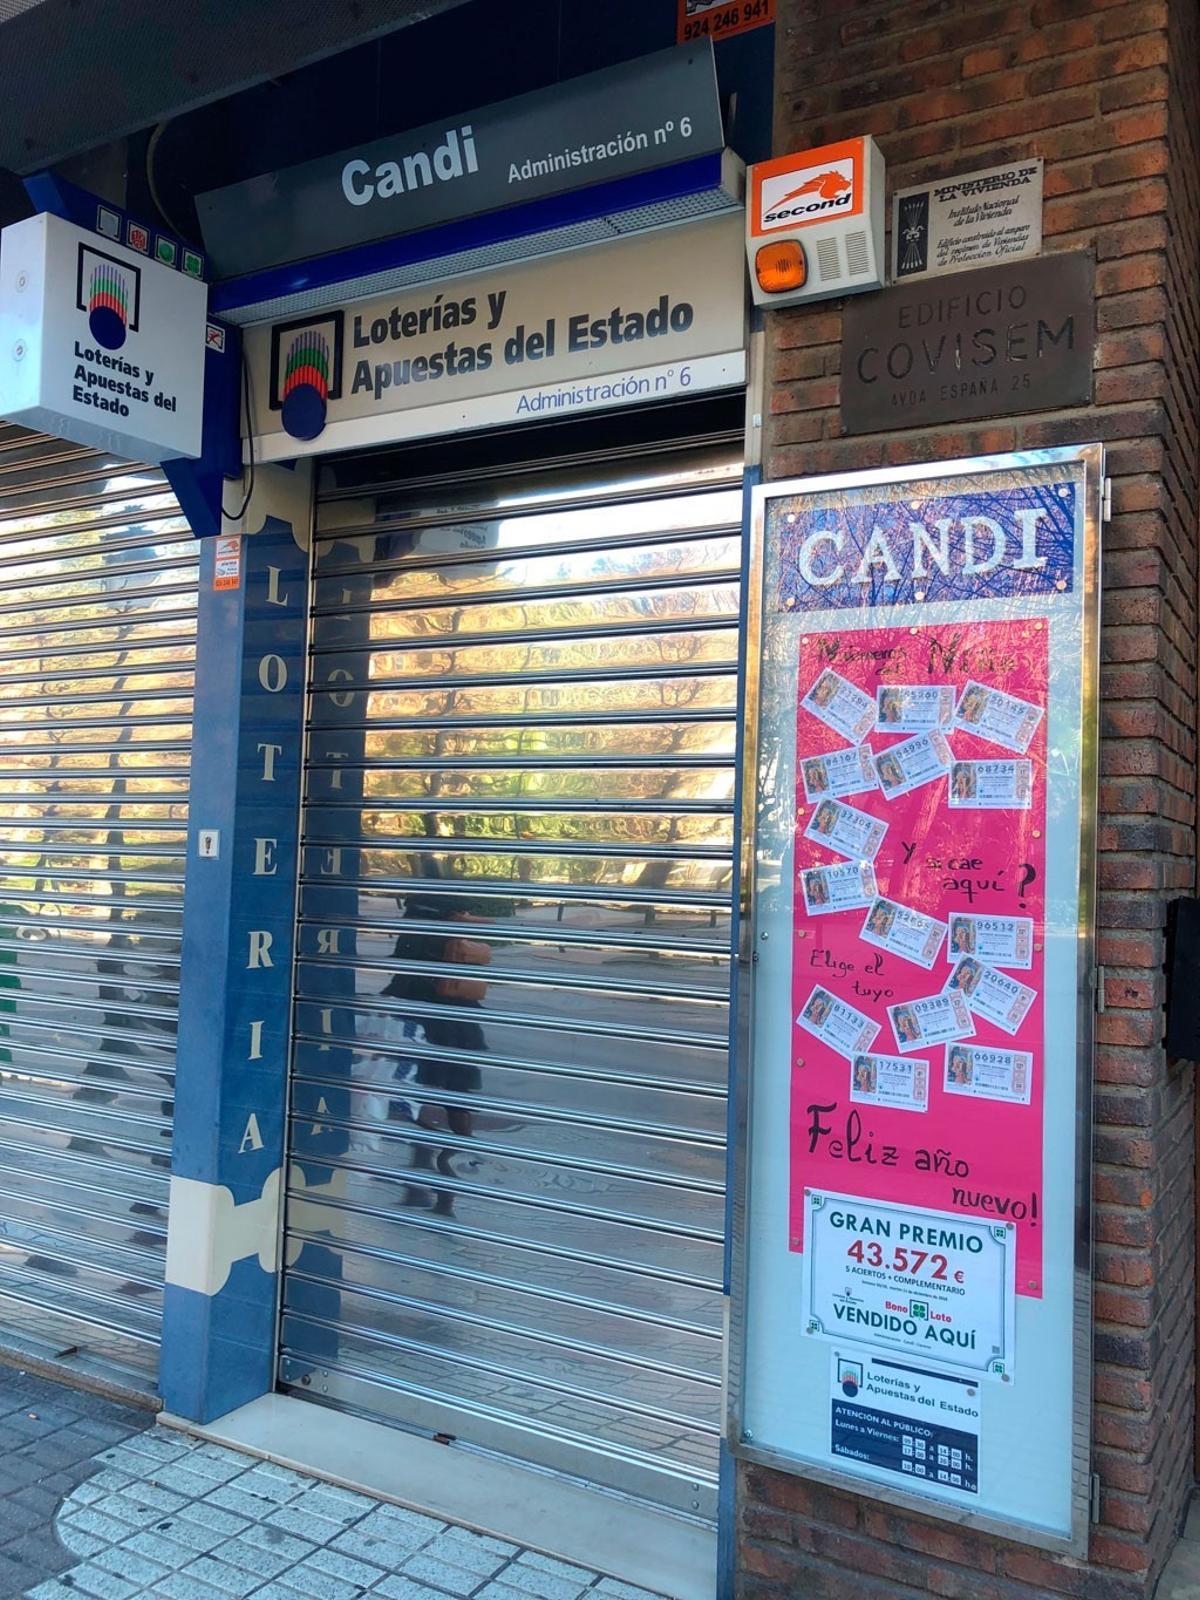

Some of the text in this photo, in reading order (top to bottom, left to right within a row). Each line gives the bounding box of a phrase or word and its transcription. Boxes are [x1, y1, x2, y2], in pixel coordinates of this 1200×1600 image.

[684, 0, 768, 40] 924 246 941
[342, 125, 480, 206] Candi
[508, 131, 648, 184] Administración
[680, 116, 692, 138] 6
[934, 166, 1037, 197] MINISTERIO DE
[939, 177, 1031, 202] LA VIVIENDA
[763, 193, 852, 223] second
[353, 291, 507, 349] Loterías y
[899, 285, 1027, 329] EDIFICIO
[74, 341, 154, 386] Loterías y
[351, 295, 694, 400] Apuestas del Estado
[857, 315, 1074, 384] COVISEM
[73, 385, 130, 417] Estado
[74, 365, 177, 412] Apuestas del
[516, 375, 650, 414] Administración
[679, 366, 692, 387] 6
[1011, 374, 1031, 392] 25
[798, 508, 1048, 586] CANDI
[238, 565, 288, 1154] LOTERIA
[947, 857, 983, 870] cae
[976, 921, 1015, 932] 96512
[810, 949, 885, 978] Elige el
[852, 981, 894, 1002] tuyo
[983, 970, 1019, 995] 20640
[807, 1102, 970, 1178] Feliz año
[952, 1187, 1038, 1227] nuevo!
[829, 1211, 983, 1254] GRAN PREMIO
[847, 1239, 965, 1284] 43.572 €
[851, 1266, 886, 1280] ACIERTOS
[893, 1275, 966, 1296] COMPLEMENTARIO
[833, 1303, 917, 1336] VENDIDO
[925, 1324, 976, 1350] AQUÍ
[885, 1300, 952, 1323] Bono Loto
[866, 1383, 979, 1418] Apuestas del Estado
[867, 1372, 921, 1393] Loterías y
[835, 1406, 879, 1423] ATENCIÓN
[880, 1418, 892, 1427] AL
[835, 1419, 859, 1432] Lunes
